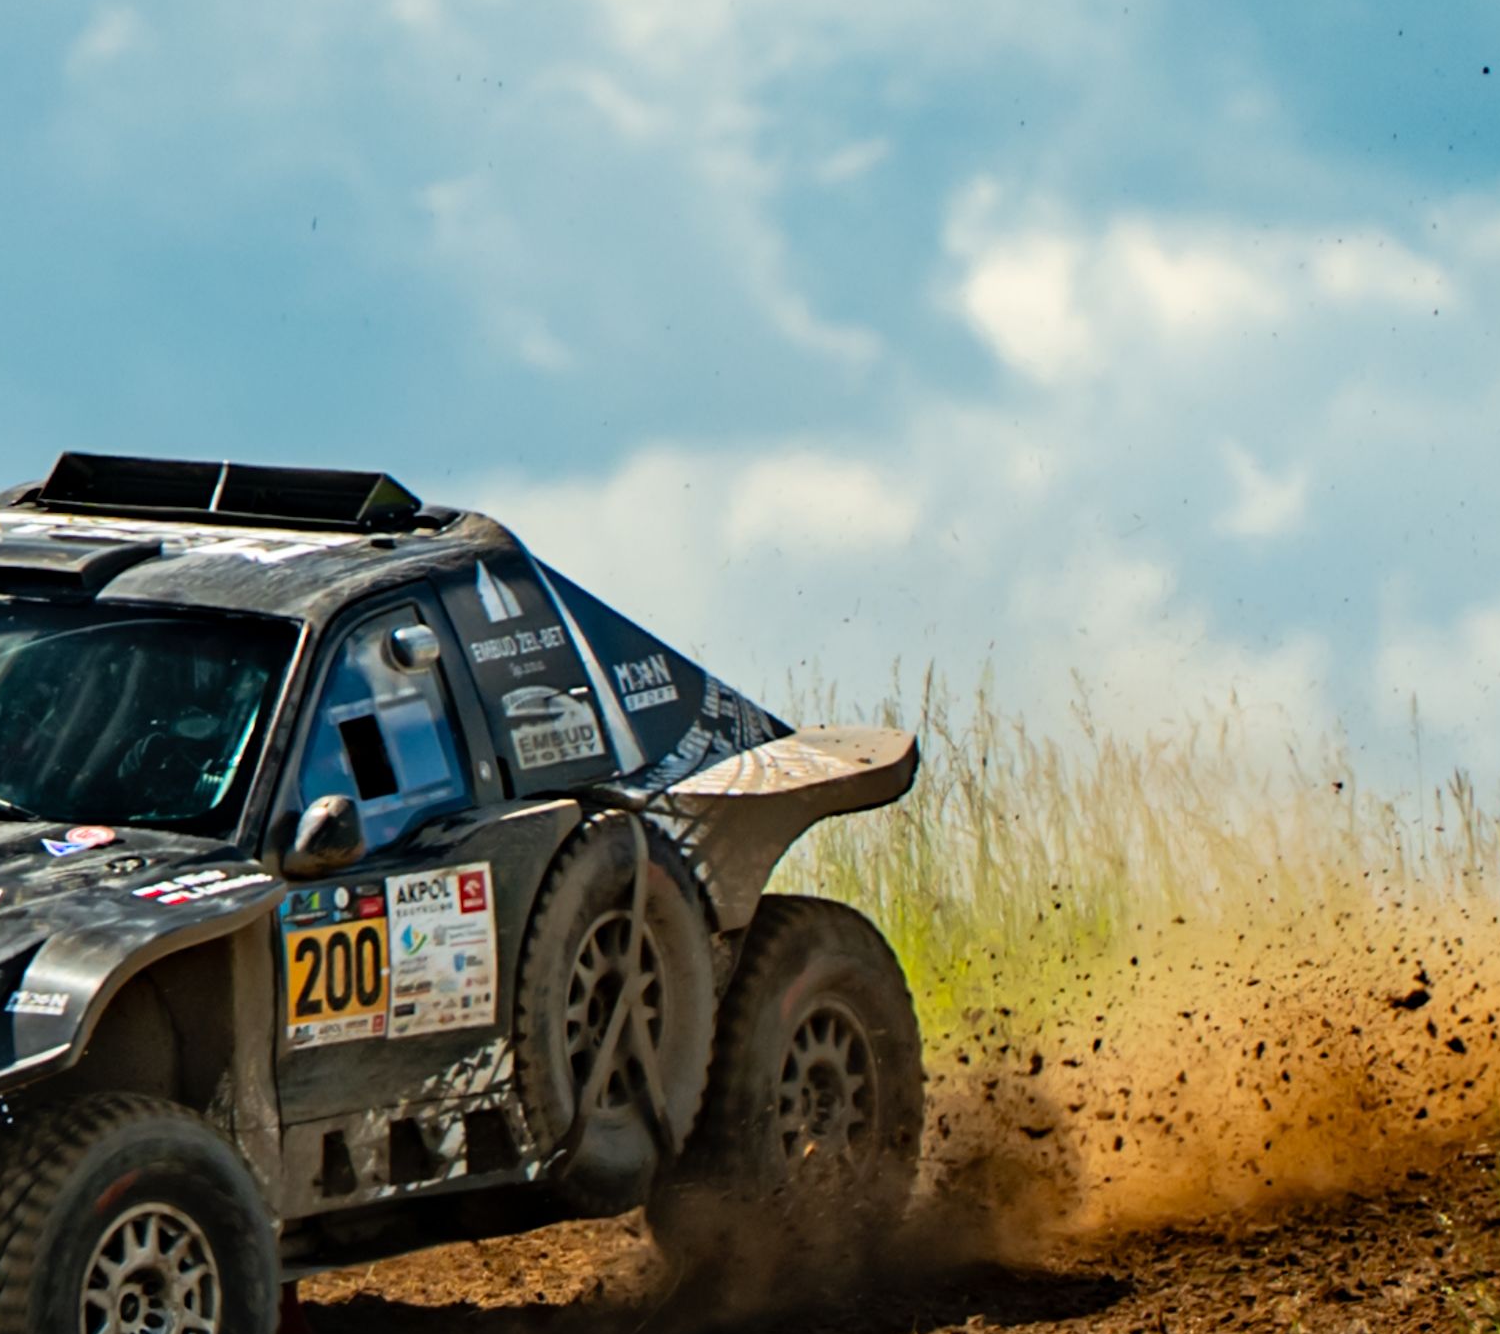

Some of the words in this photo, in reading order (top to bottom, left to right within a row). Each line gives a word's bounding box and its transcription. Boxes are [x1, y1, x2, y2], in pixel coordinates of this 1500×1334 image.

[470, 635, 518, 663] EMBUD
[517, 723, 595, 754] EMBUD
[523, 741, 597, 765] MOSTY
[396, 877, 452, 906] AKPOL
[295, 925, 383, 1018] 200
